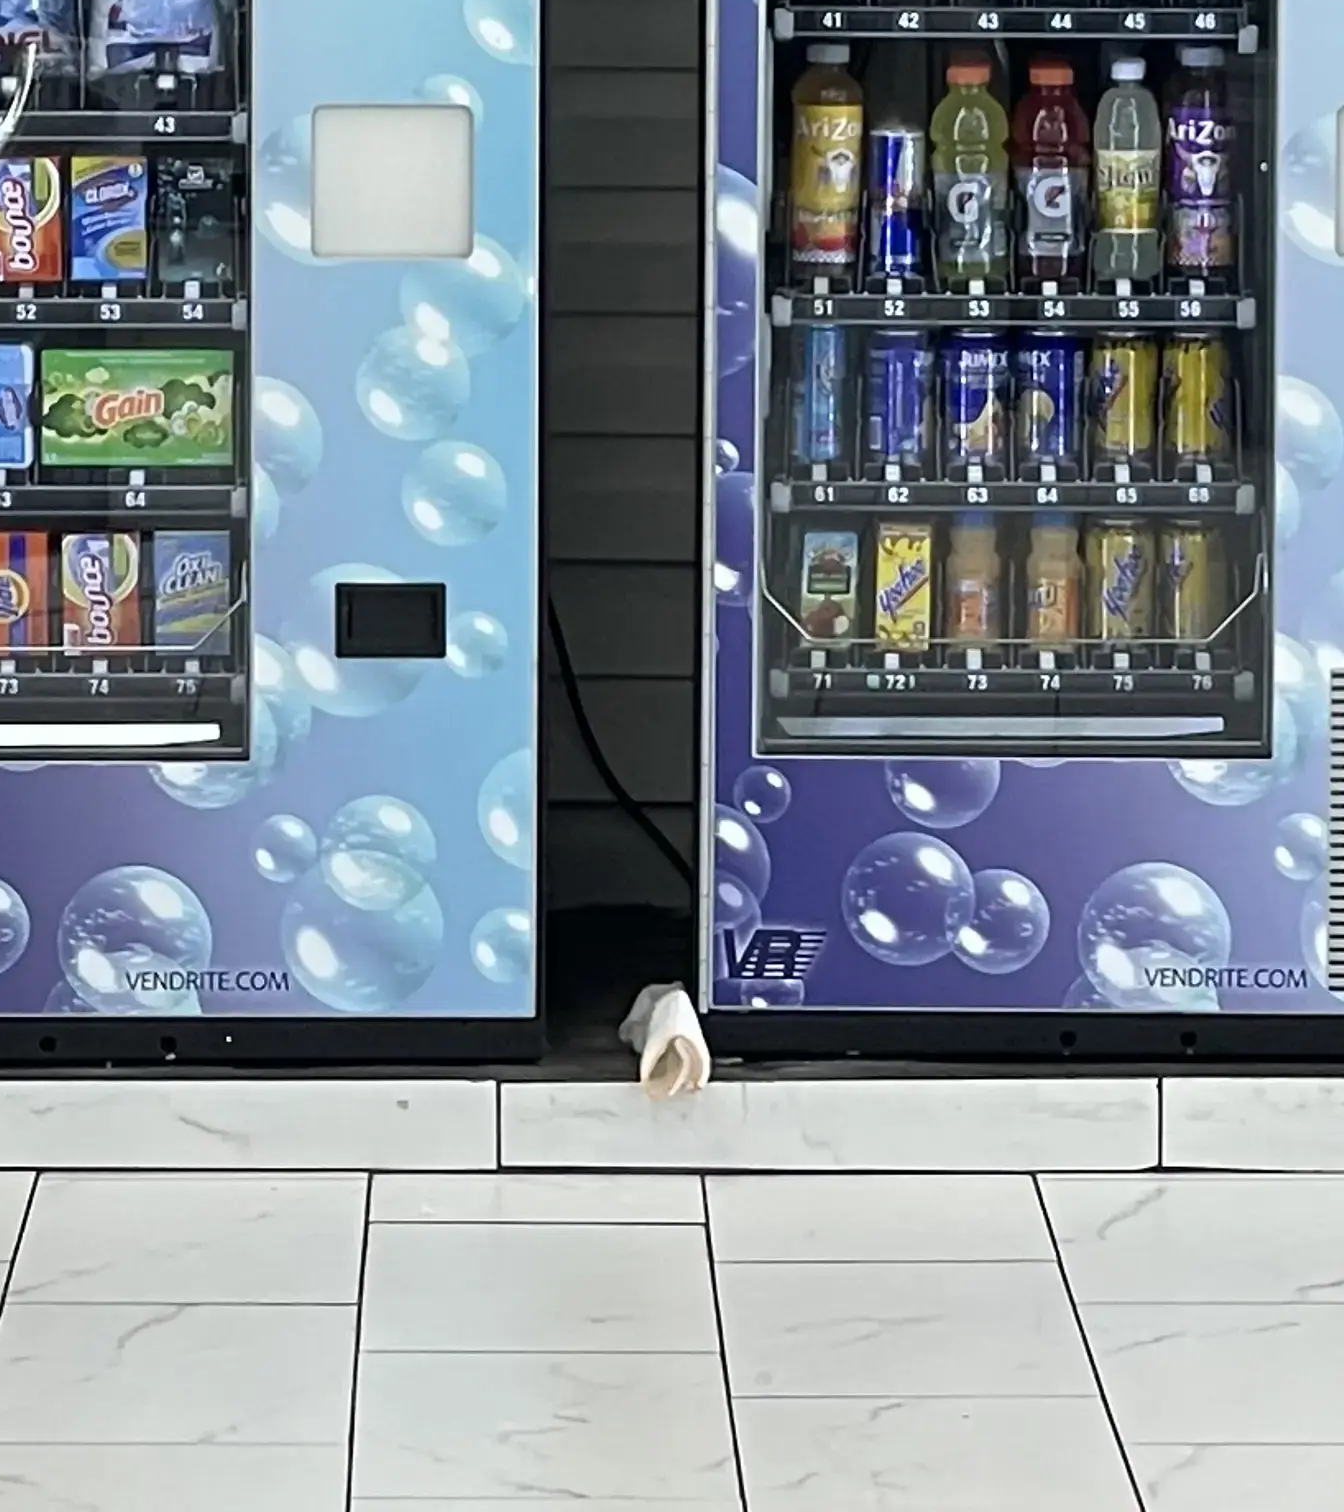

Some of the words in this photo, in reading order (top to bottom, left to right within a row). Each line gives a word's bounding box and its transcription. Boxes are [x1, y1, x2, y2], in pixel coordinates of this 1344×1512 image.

[822, 12, 842, 28] 41
[898, 12, 919, 29] 42
[977, 12, 999, 29] 43
[1050, 13, 1072, 29] 44
[1124, 13, 1146, 29] 45
[1195, 13, 1217, 29] 46
[154, 116, 176, 133] 43
[2, 178, 36, 271] bounce
[16, 304, 37, 321] 52
[100, 304, 121, 321] 53
[183, 304, 204, 321] 54
[813, 300, 833, 315] 51
[884, 300, 905, 316] 52
[969, 300, 990, 317] 53
[1044, 301, 1065, 317] 54
[1118, 301, 1140, 317] 55
[1180, 301, 1201, 317] 56
[94, 389, 163, 427] Gain
[125, 491, 146, 508] 64
[814, 486, 834, 502] 61
[887, 487, 909, 503] 62
[967, 487, 988, 503] 63
[1037, 488, 1058, 504] 64
[1116, 488, 1137, 504] 65
[164, 567, 218, 594] CLEAN
[79, 553, 113, 645] bounce
[0, 678, 19, 694] 73
[88, 679, 109, 694] 74
[176, 678, 197, 694] 75
[813, 674, 832, 688] 71
[885, 674, 906, 690] 72
[967, 674, 988, 690] 73
[1040, 674, 1061, 691] 74
[1113, 675, 1134, 691] 75
[1192, 675, 1212, 690] 76
[125, 970, 291, 992] VENDRITE.COM
[1144, 967, 1309, 989] VENDRITE.COM
